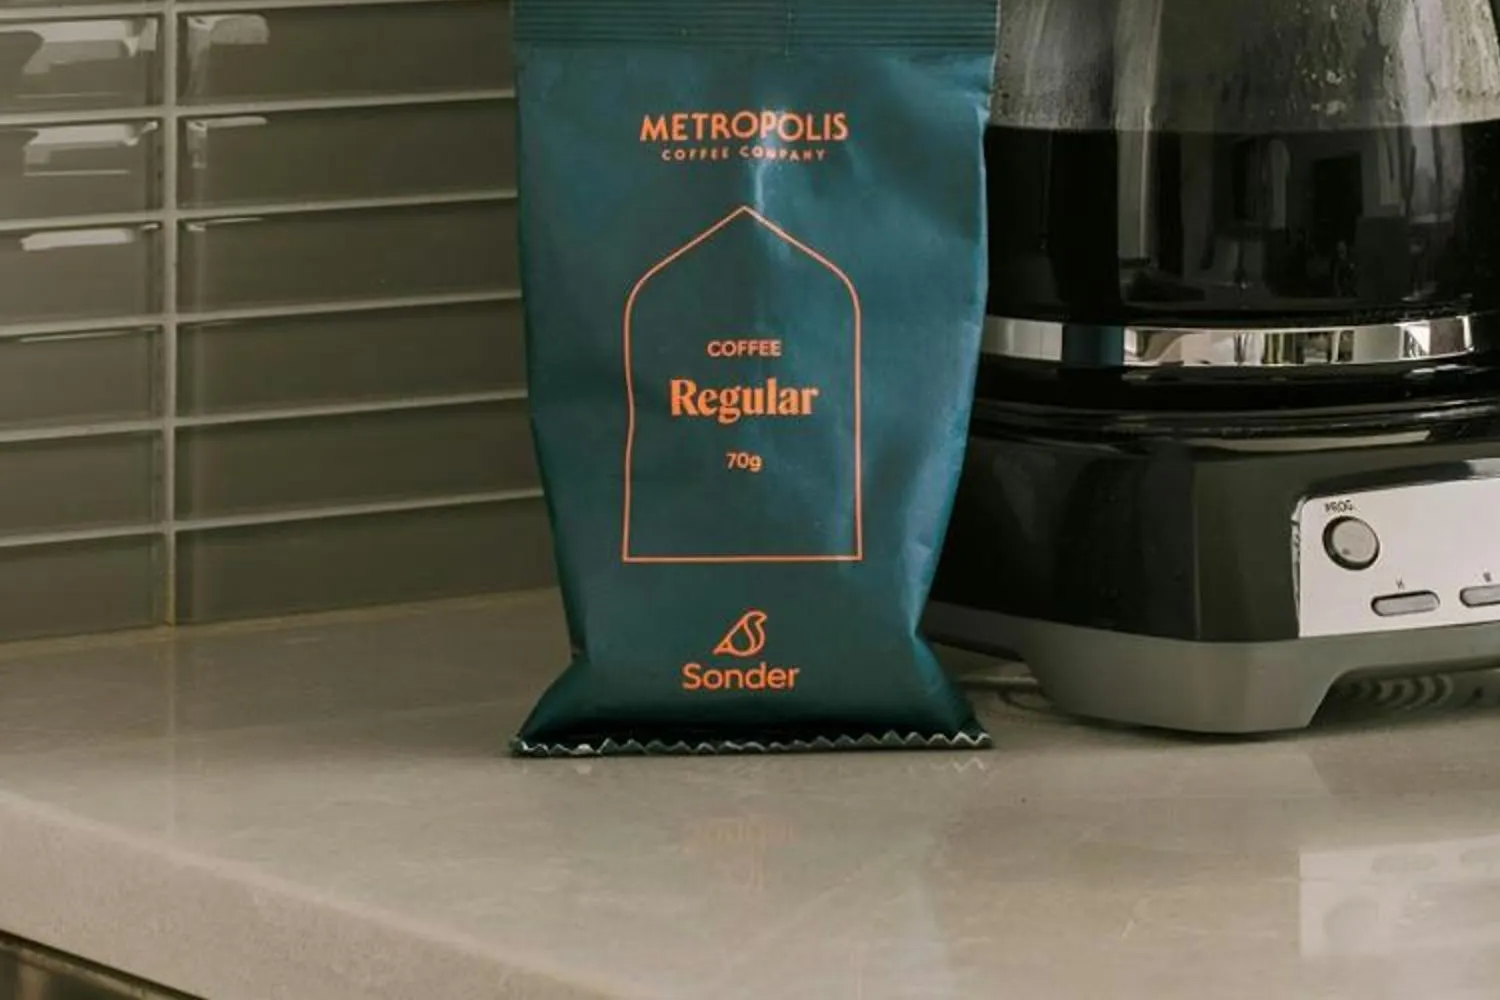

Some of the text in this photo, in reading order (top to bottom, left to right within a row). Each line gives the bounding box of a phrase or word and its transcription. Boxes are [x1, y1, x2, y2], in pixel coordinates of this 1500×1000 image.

[639, 111, 849, 143] METROPOLIS
[661, 145, 826, 162] COFFEE COMPANY
[707, 339, 782, 357] COFFEE
[670, 377, 820, 424] Regular
[726, 452, 763, 472] 70g
[682, 662, 800, 690] Sonder
